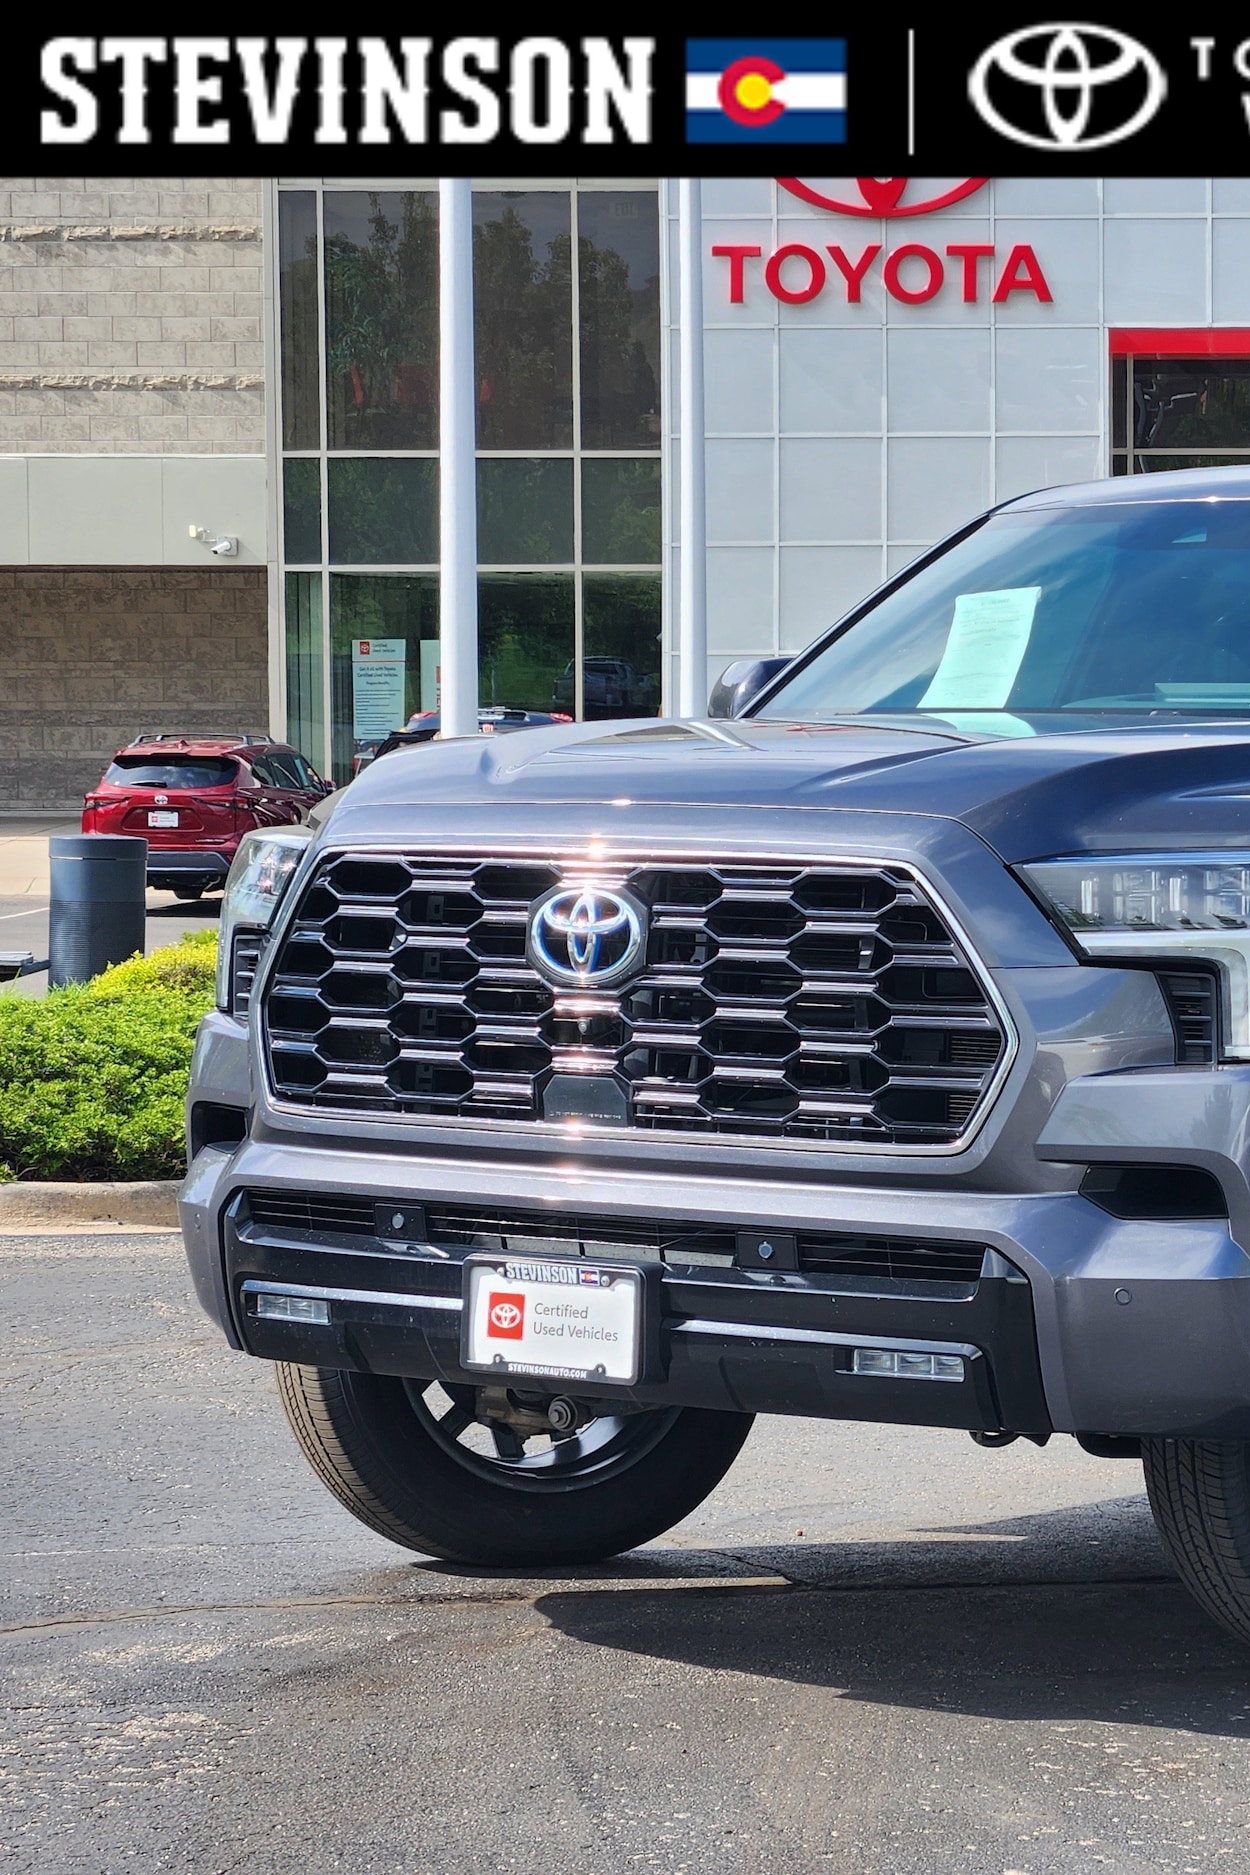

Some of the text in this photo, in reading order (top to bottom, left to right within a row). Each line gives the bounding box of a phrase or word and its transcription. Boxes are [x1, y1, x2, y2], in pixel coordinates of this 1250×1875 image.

[711, 243, 1053, 304] TOYOTA
[505, 1262, 578, 1284] STEVINSON
[534, 1302, 589, 1319] Certified
[533, 1321, 618, 1342] Used Vehicles
[507, 1363, 588, 1379] STEVINSONAUTO.COM
